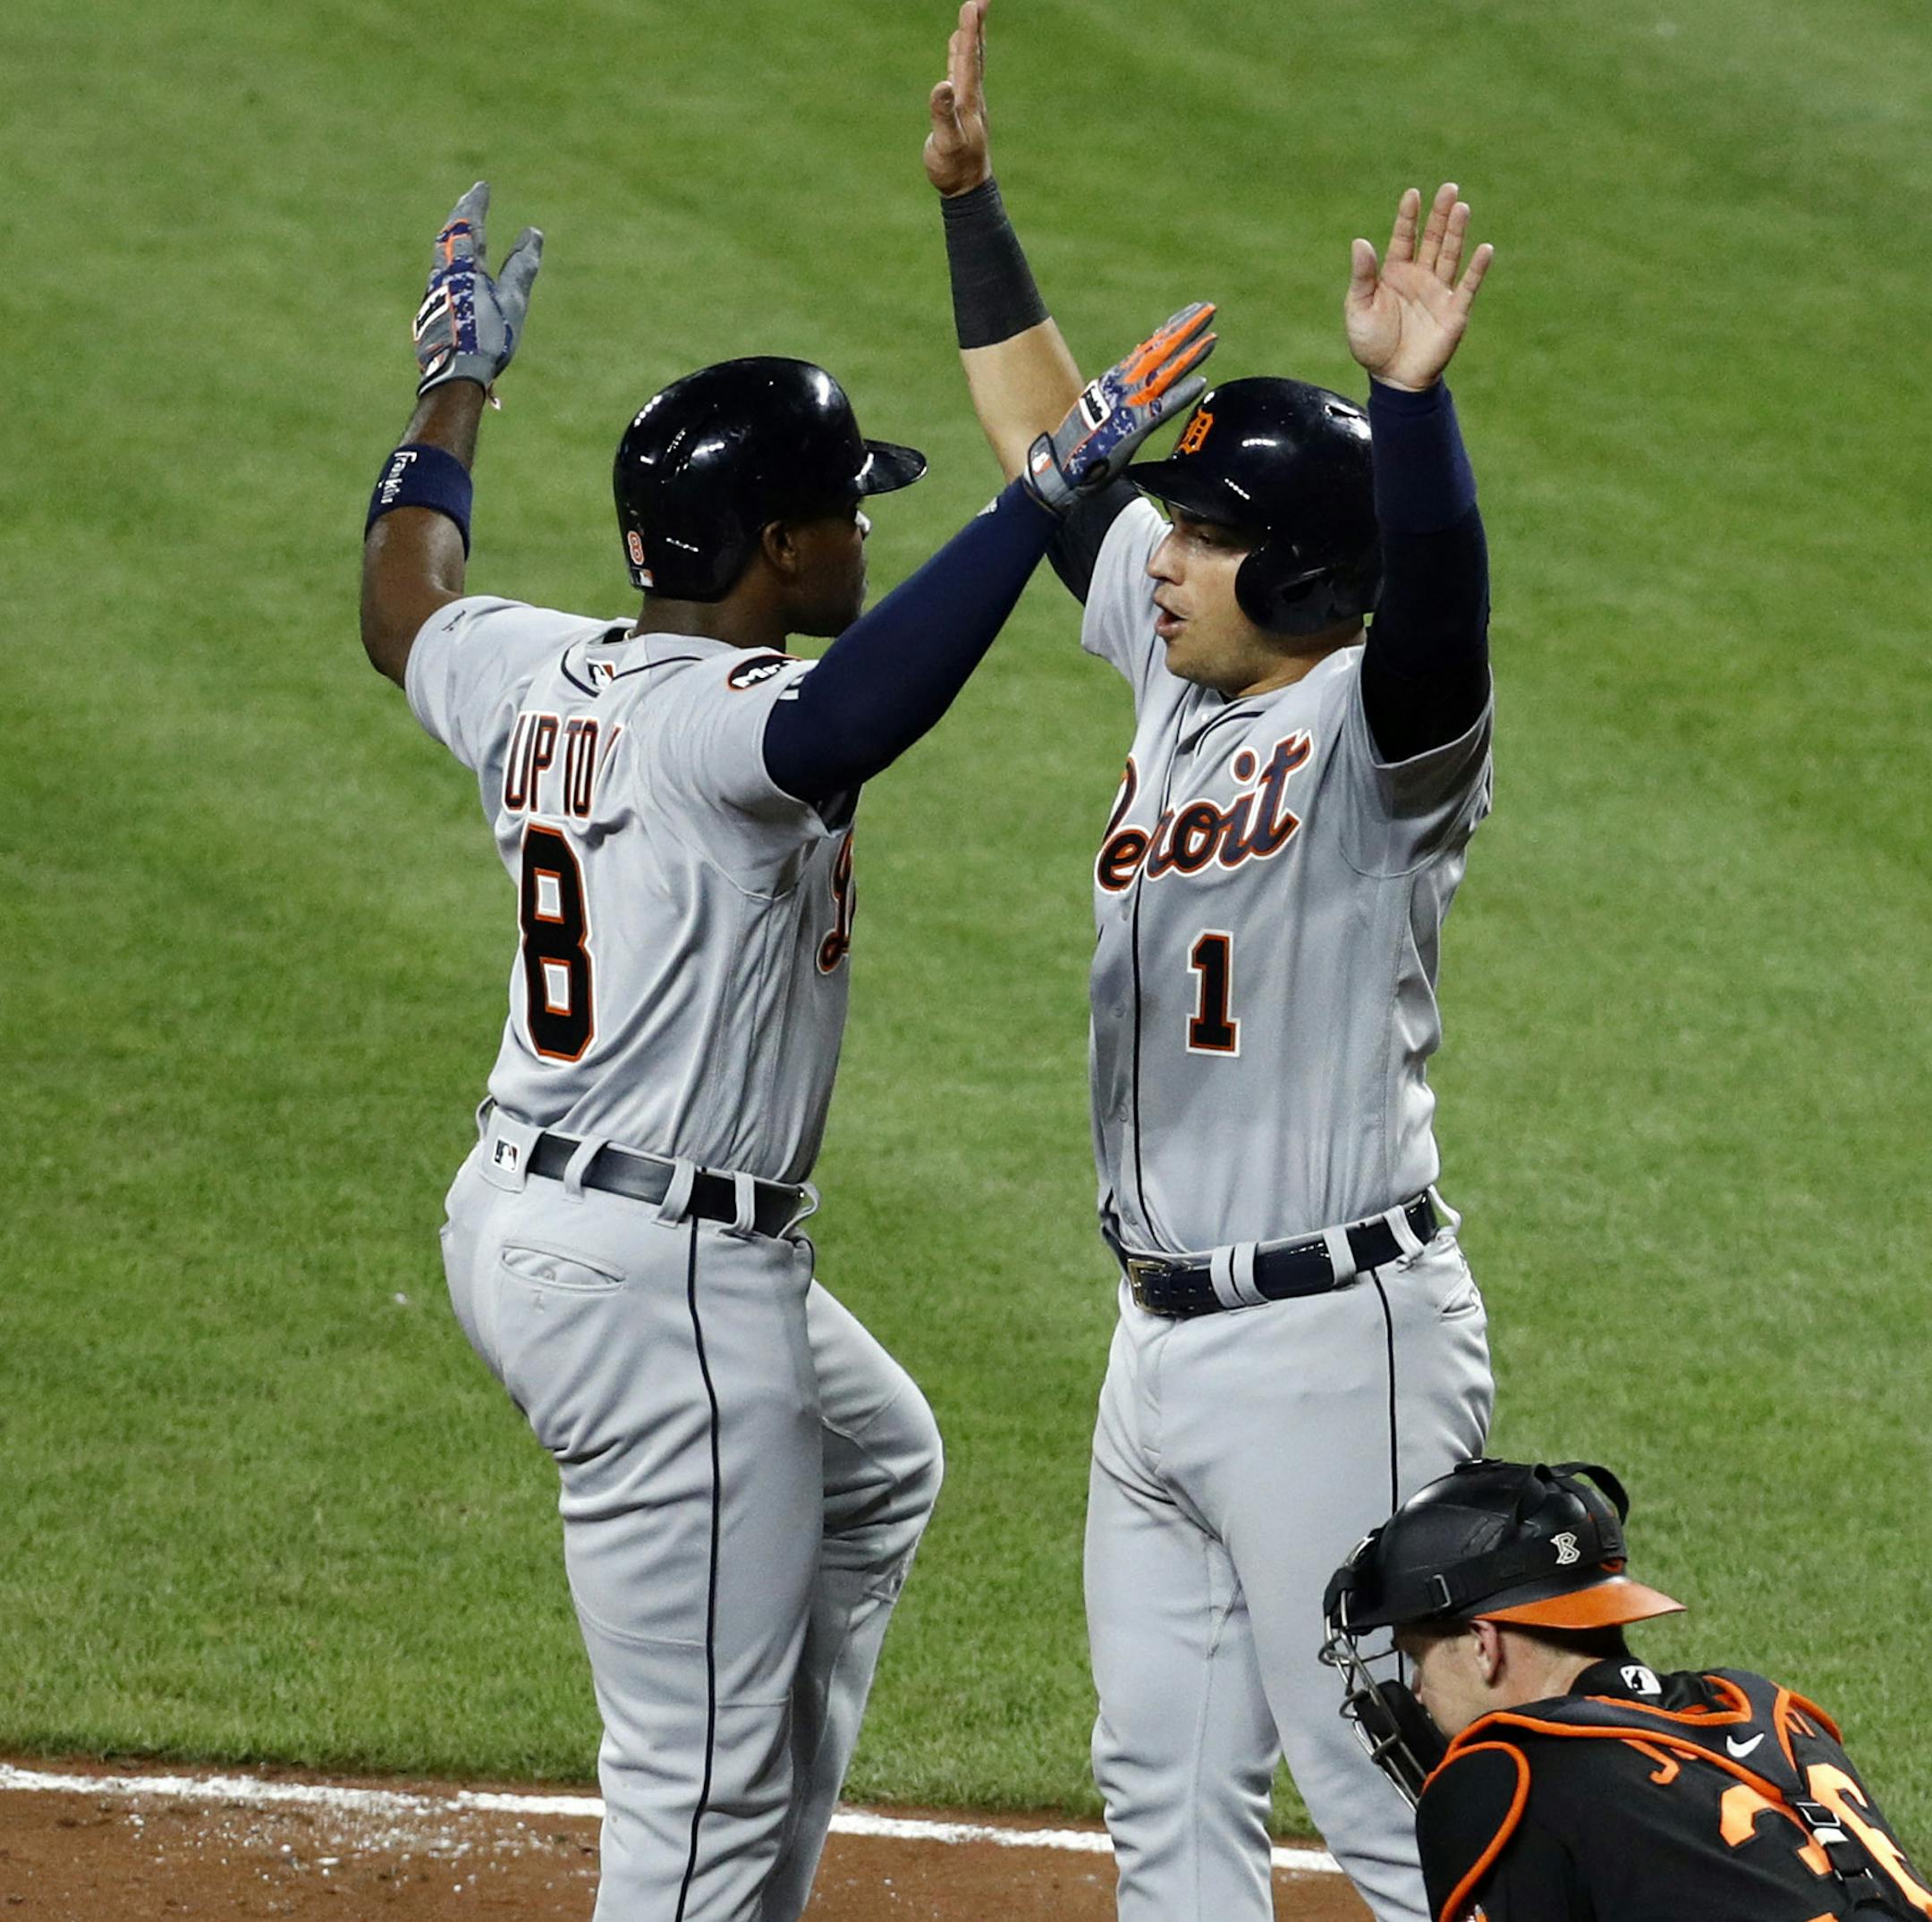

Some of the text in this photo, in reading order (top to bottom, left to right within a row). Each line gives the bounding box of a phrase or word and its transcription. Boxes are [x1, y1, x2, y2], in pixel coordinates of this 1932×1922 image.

[627, 530, 645, 565] 8
[502, 711, 623, 819] UPTO
[517, 815, 598, 1067] 8
[1186, 928, 1242, 1057] 1
[1549, 1530, 1581, 1565] B
